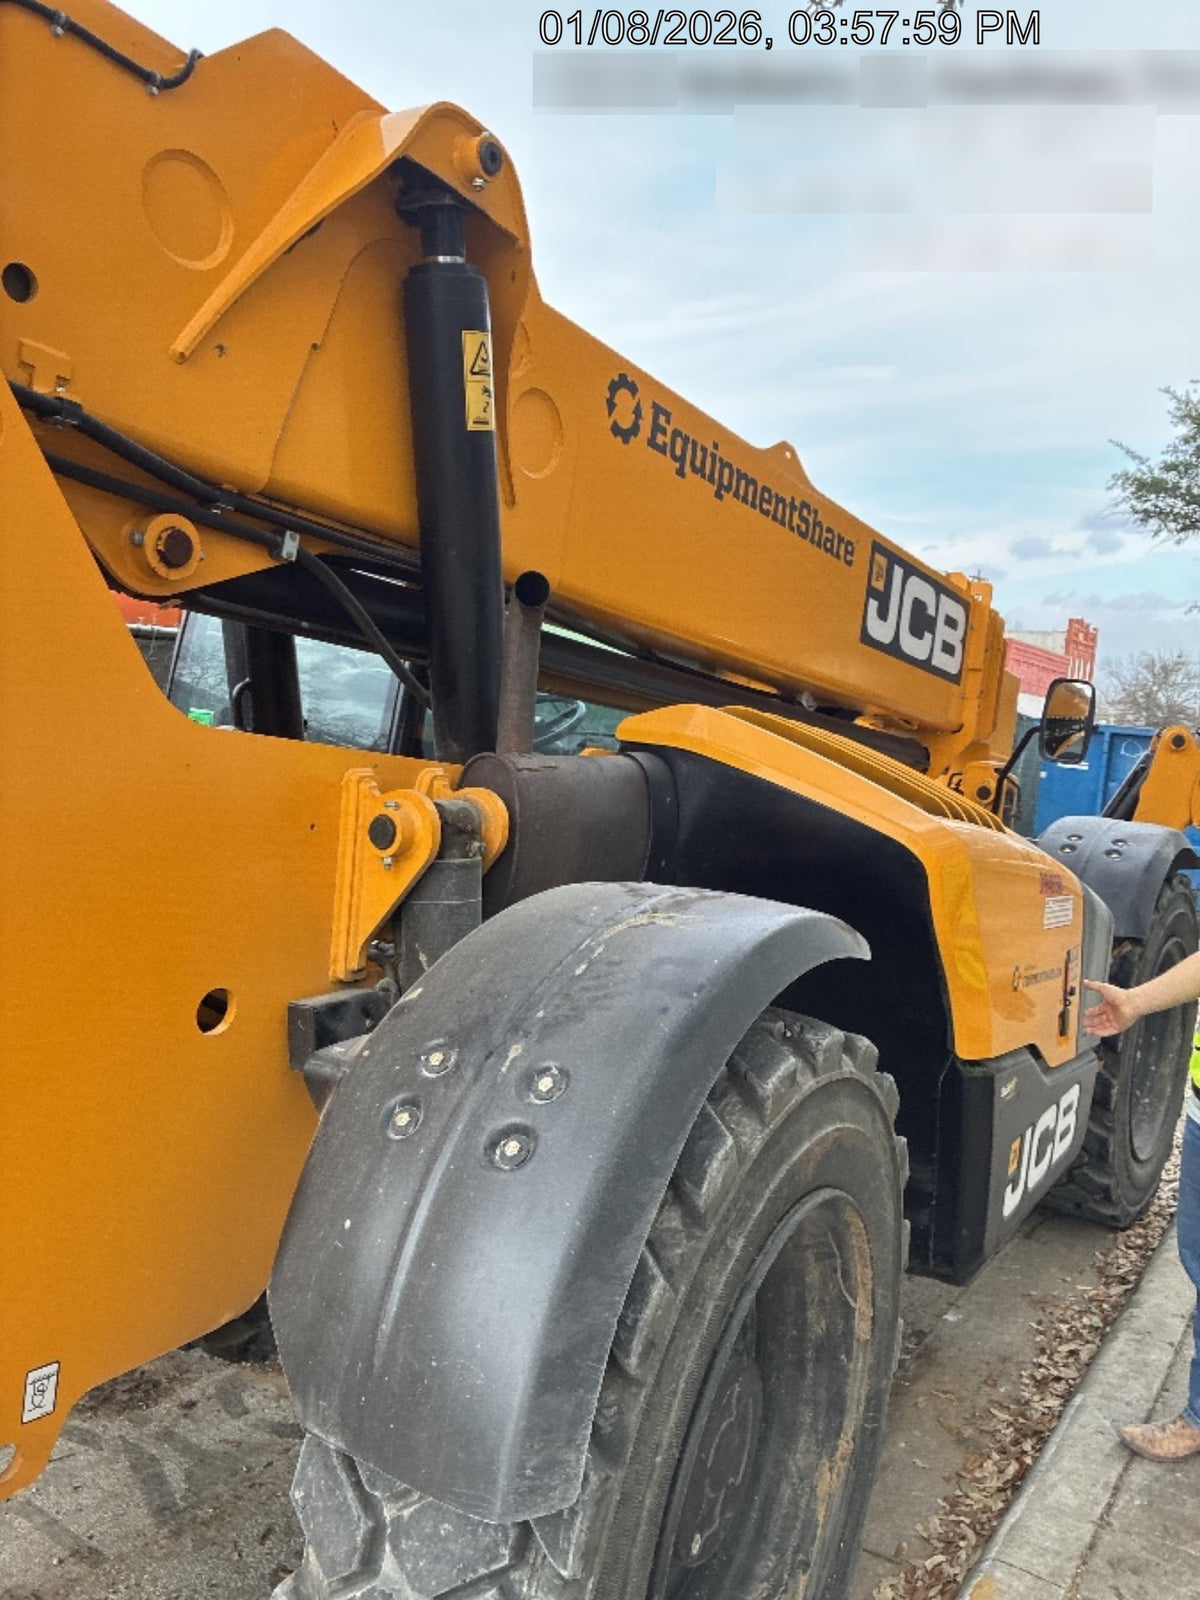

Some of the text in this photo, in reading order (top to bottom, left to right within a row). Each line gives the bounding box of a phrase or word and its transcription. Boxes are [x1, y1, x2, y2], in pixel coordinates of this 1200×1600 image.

[646, 400, 855, 567] EquipmentShare
[866, 564, 967, 675] JCB
[1003, 1084, 1081, 1218] JCB
